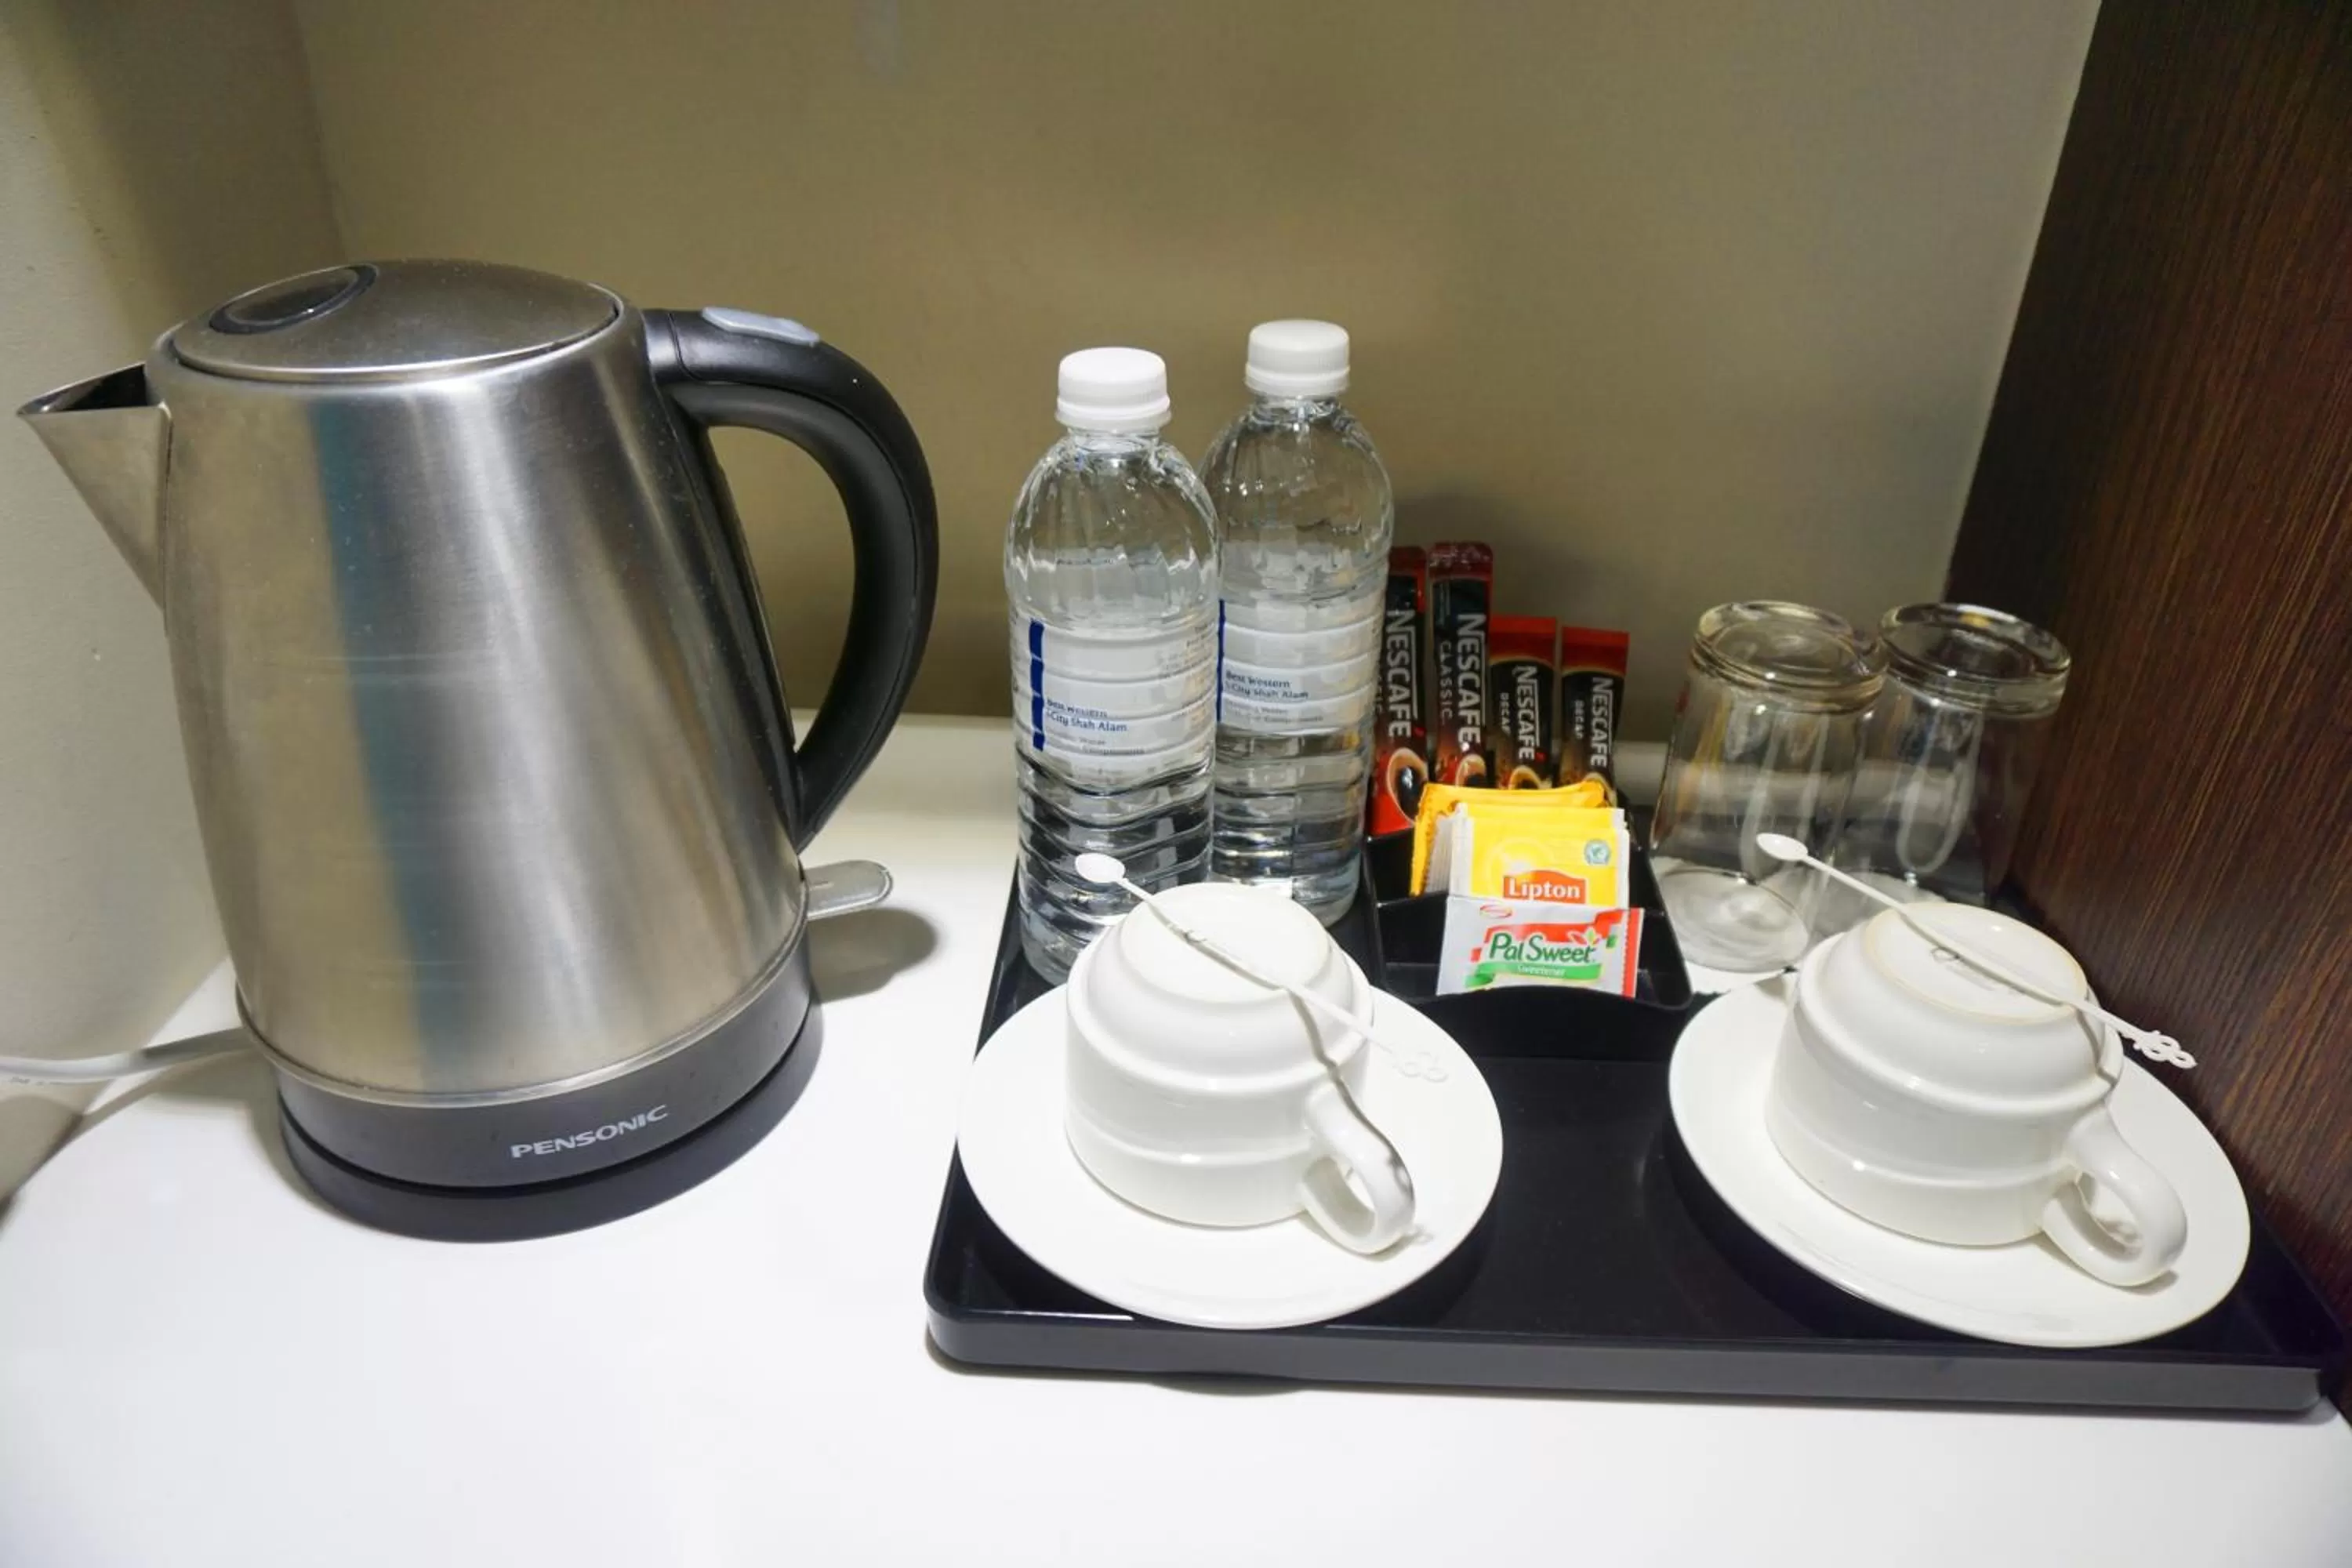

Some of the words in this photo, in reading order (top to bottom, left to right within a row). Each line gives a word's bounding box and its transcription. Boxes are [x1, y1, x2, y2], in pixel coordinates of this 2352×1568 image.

[1440, 641, 1453, 720] CLASSIC
[1098, 720, 1127, 731] Alam
[1507, 877, 1581, 901] Lipton
[510, 1104, 669, 1158] PENSONIC
